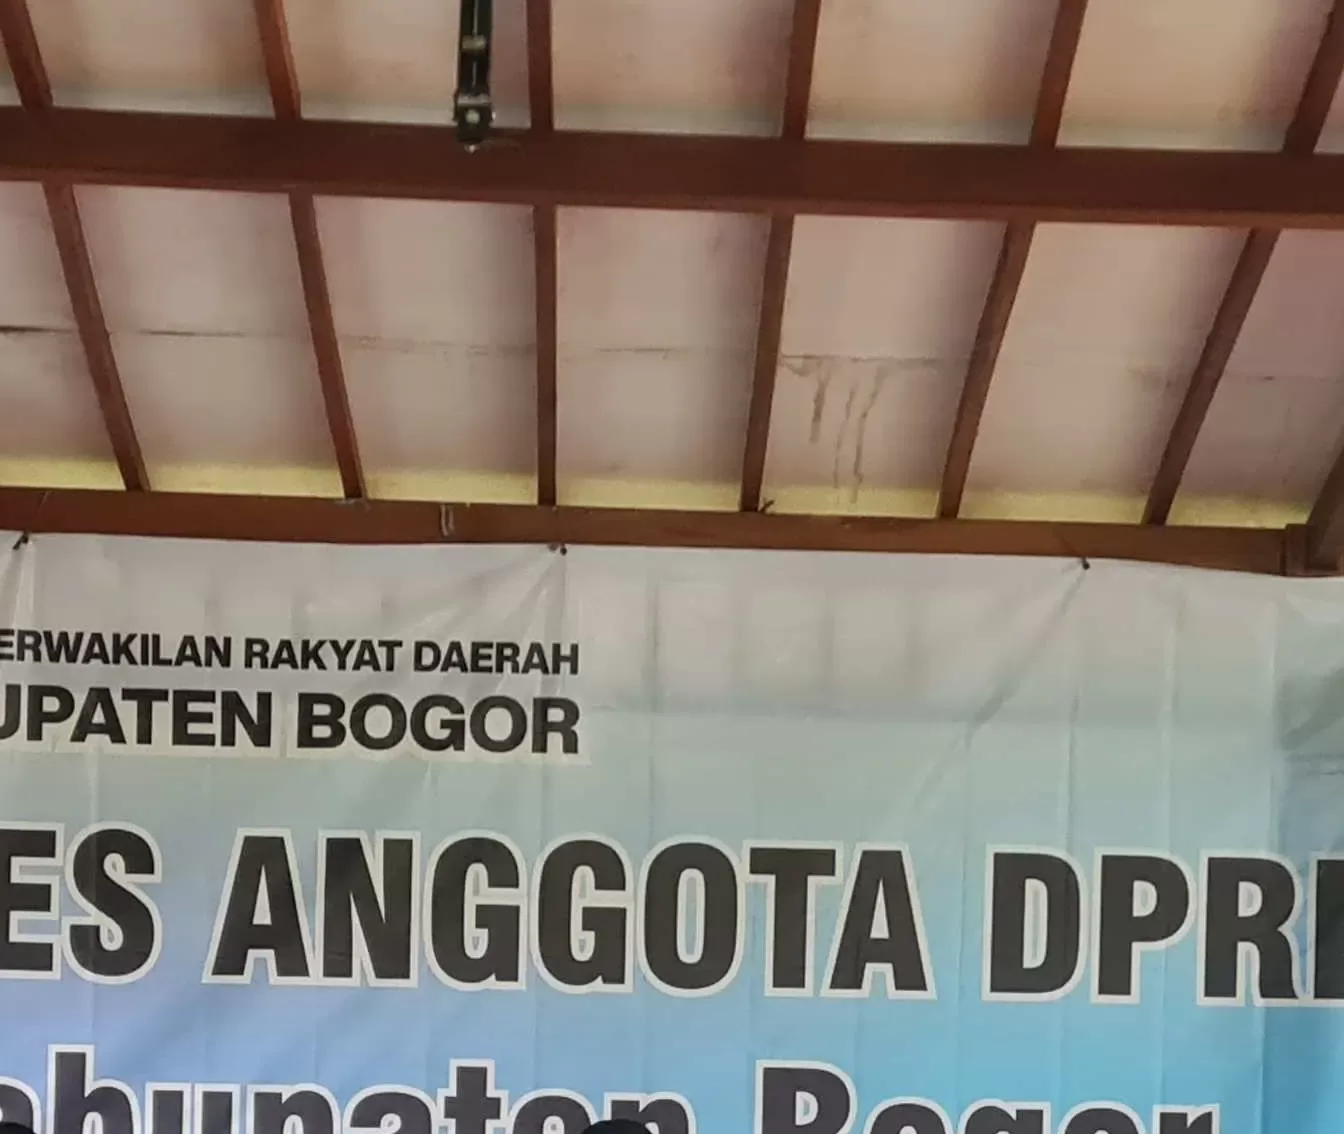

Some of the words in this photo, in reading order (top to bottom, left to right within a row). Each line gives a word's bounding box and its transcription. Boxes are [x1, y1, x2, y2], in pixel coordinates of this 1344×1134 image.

[243, 636, 404, 672] RAKYAT
[412, 640, 580, 676] DAERAH
[296, 691, 580, 755] BOGOR
[203, 825, 935, 1000] ANGGOTA
